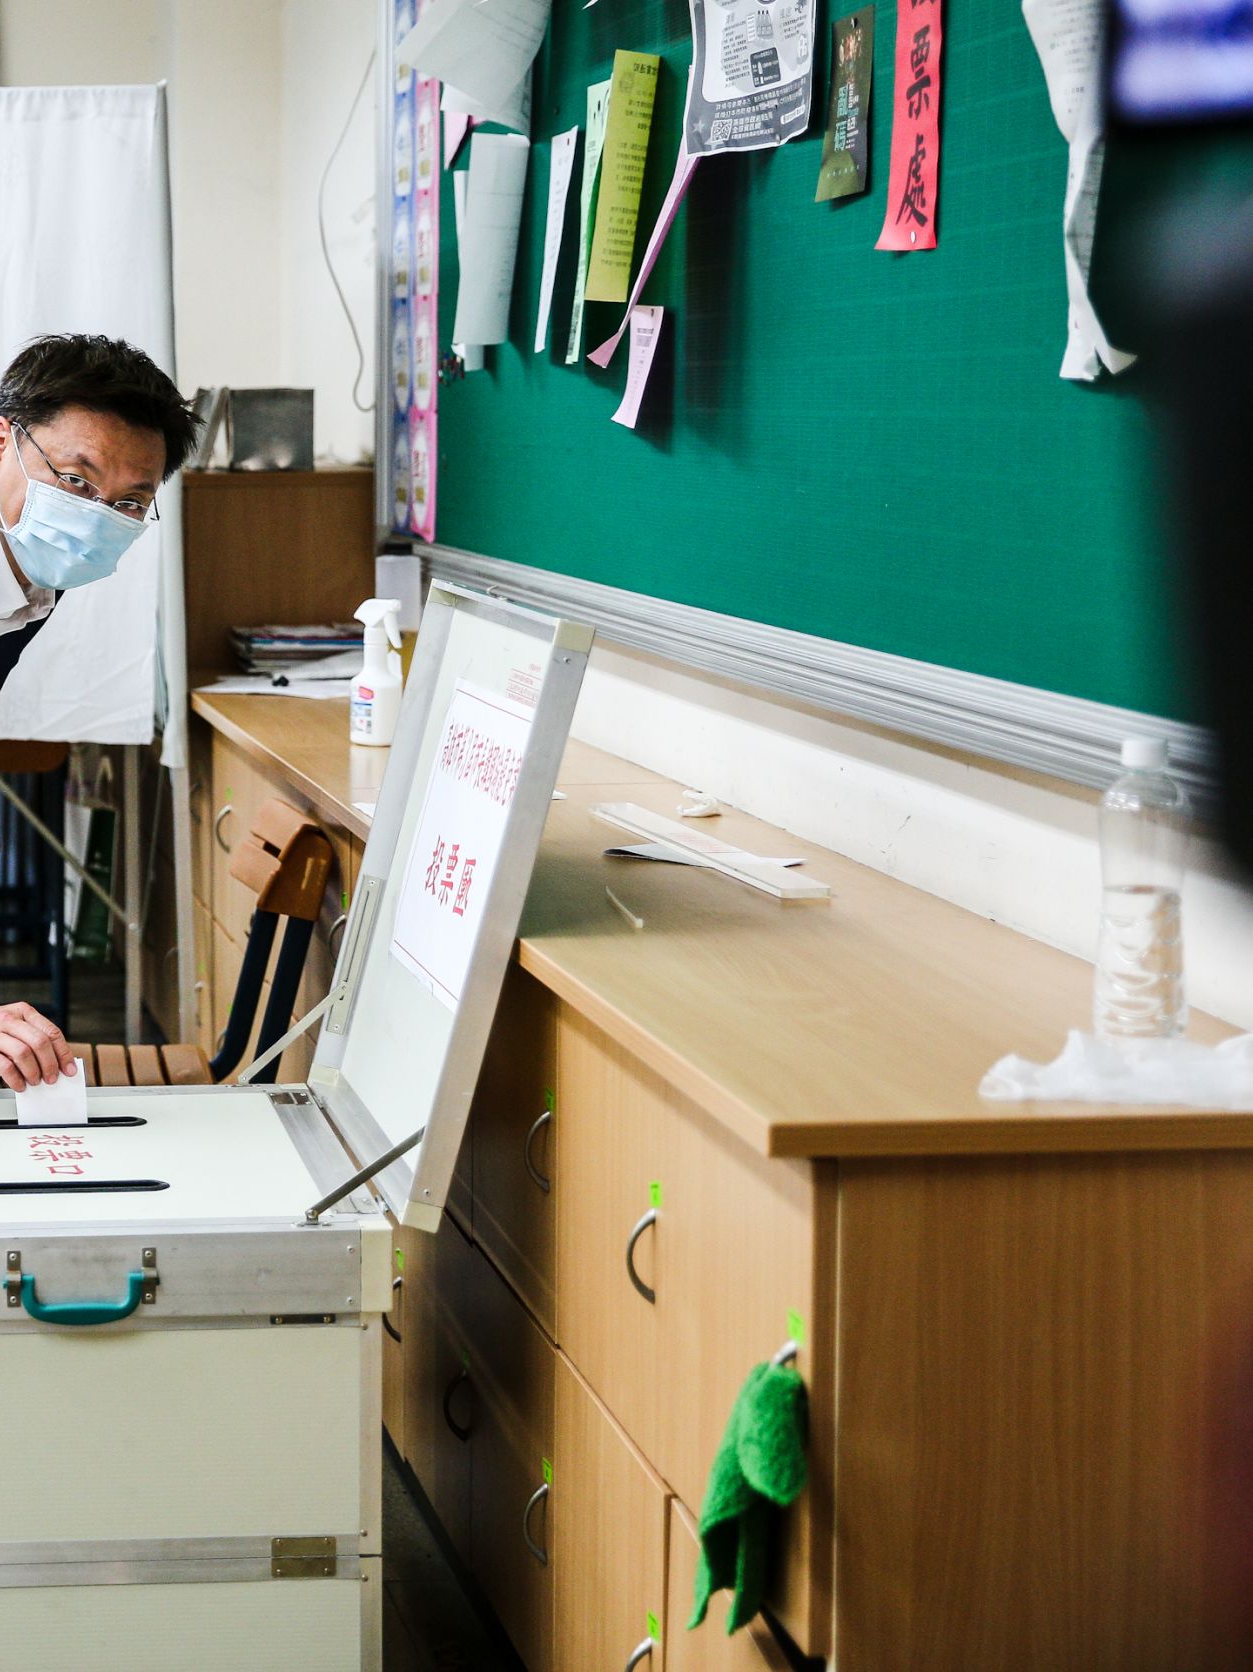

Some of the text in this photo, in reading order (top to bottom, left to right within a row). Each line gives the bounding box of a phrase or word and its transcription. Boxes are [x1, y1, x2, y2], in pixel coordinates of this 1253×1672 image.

[895, 0, 936, 227] 票處
[27, 1134, 93, 1175] 投票口
